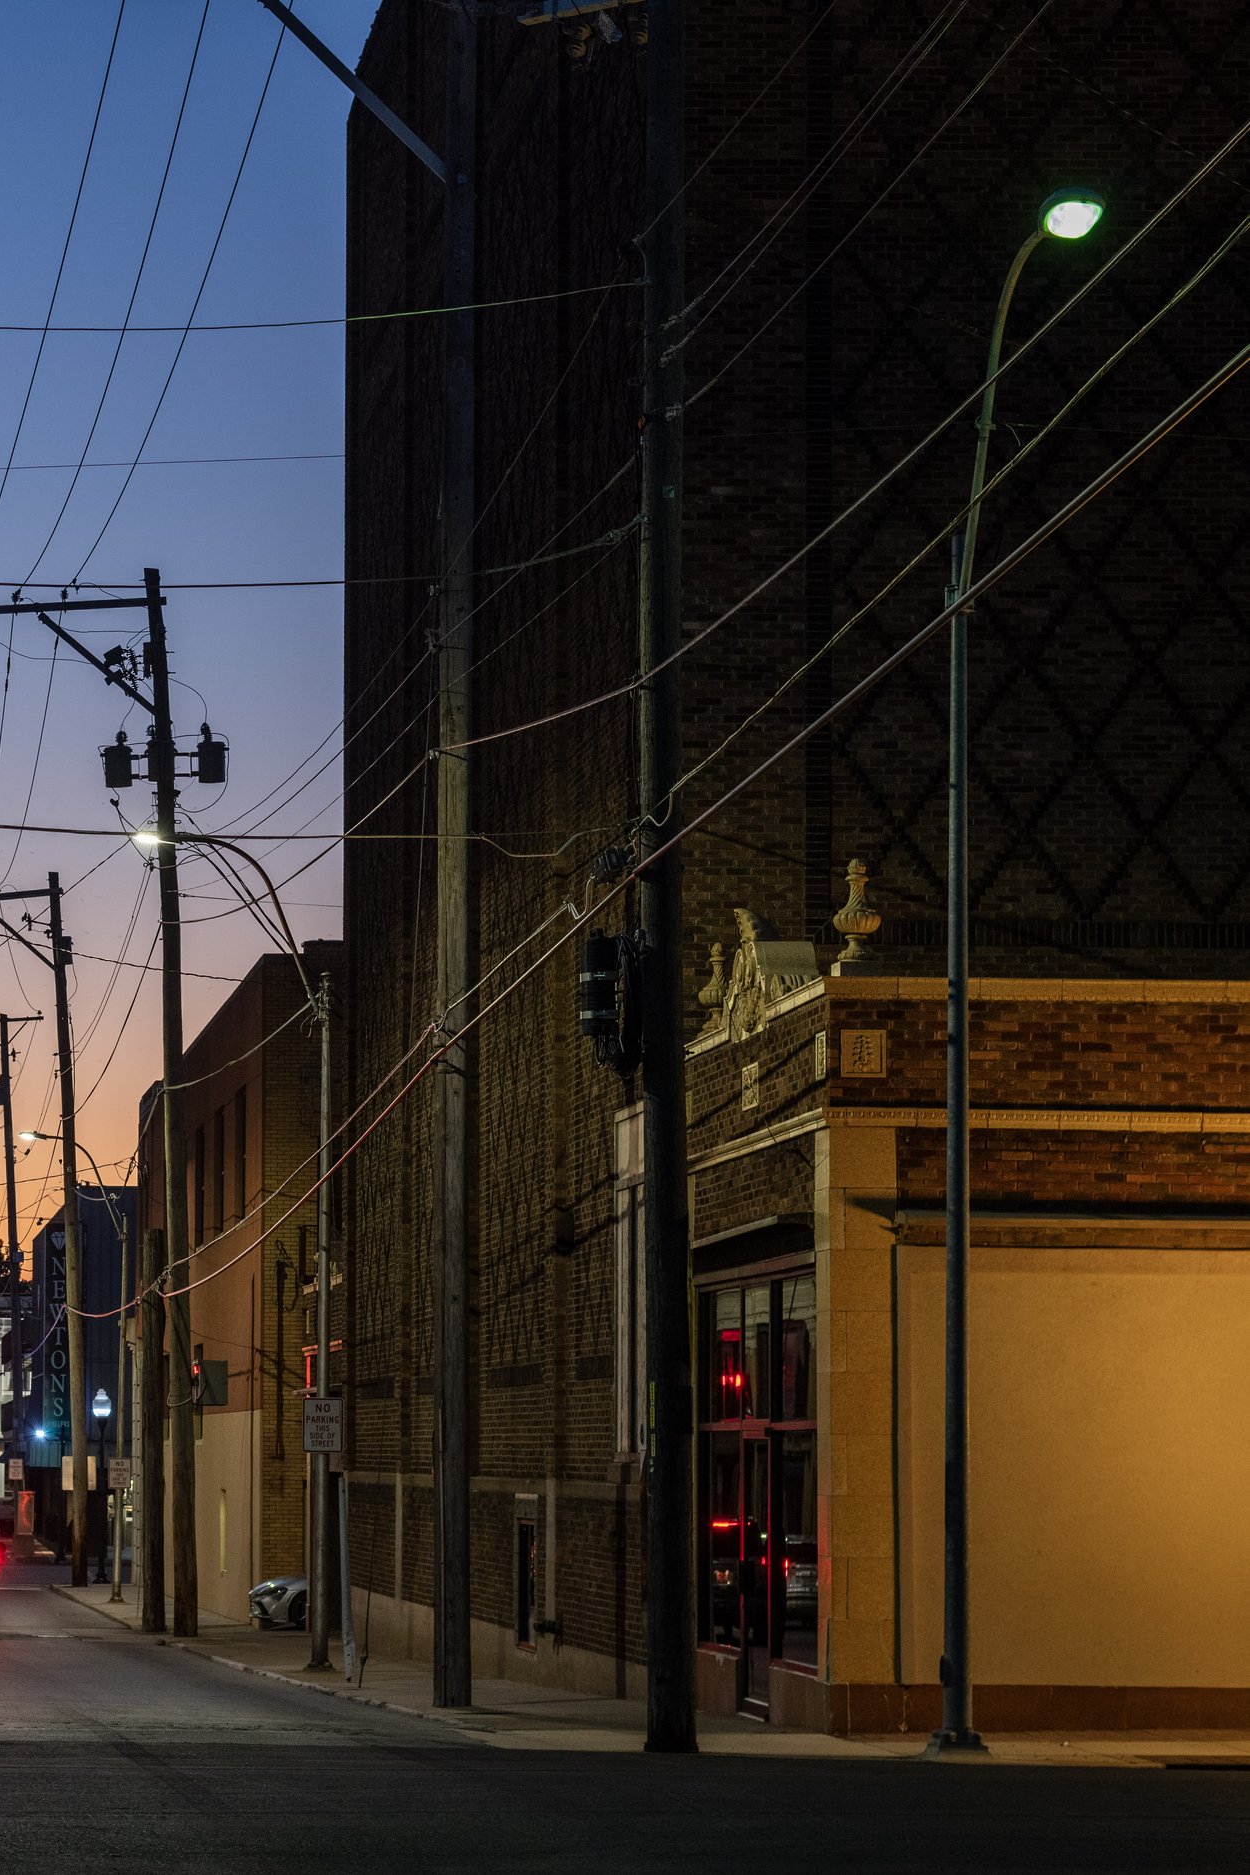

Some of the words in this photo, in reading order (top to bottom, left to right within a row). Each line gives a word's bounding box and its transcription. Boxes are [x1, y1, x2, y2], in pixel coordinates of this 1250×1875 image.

[49, 1256, 66, 1417] NEWTONS
[315, 1403, 331, 1413] NO
[306, 1415, 340, 1424] PARKING
